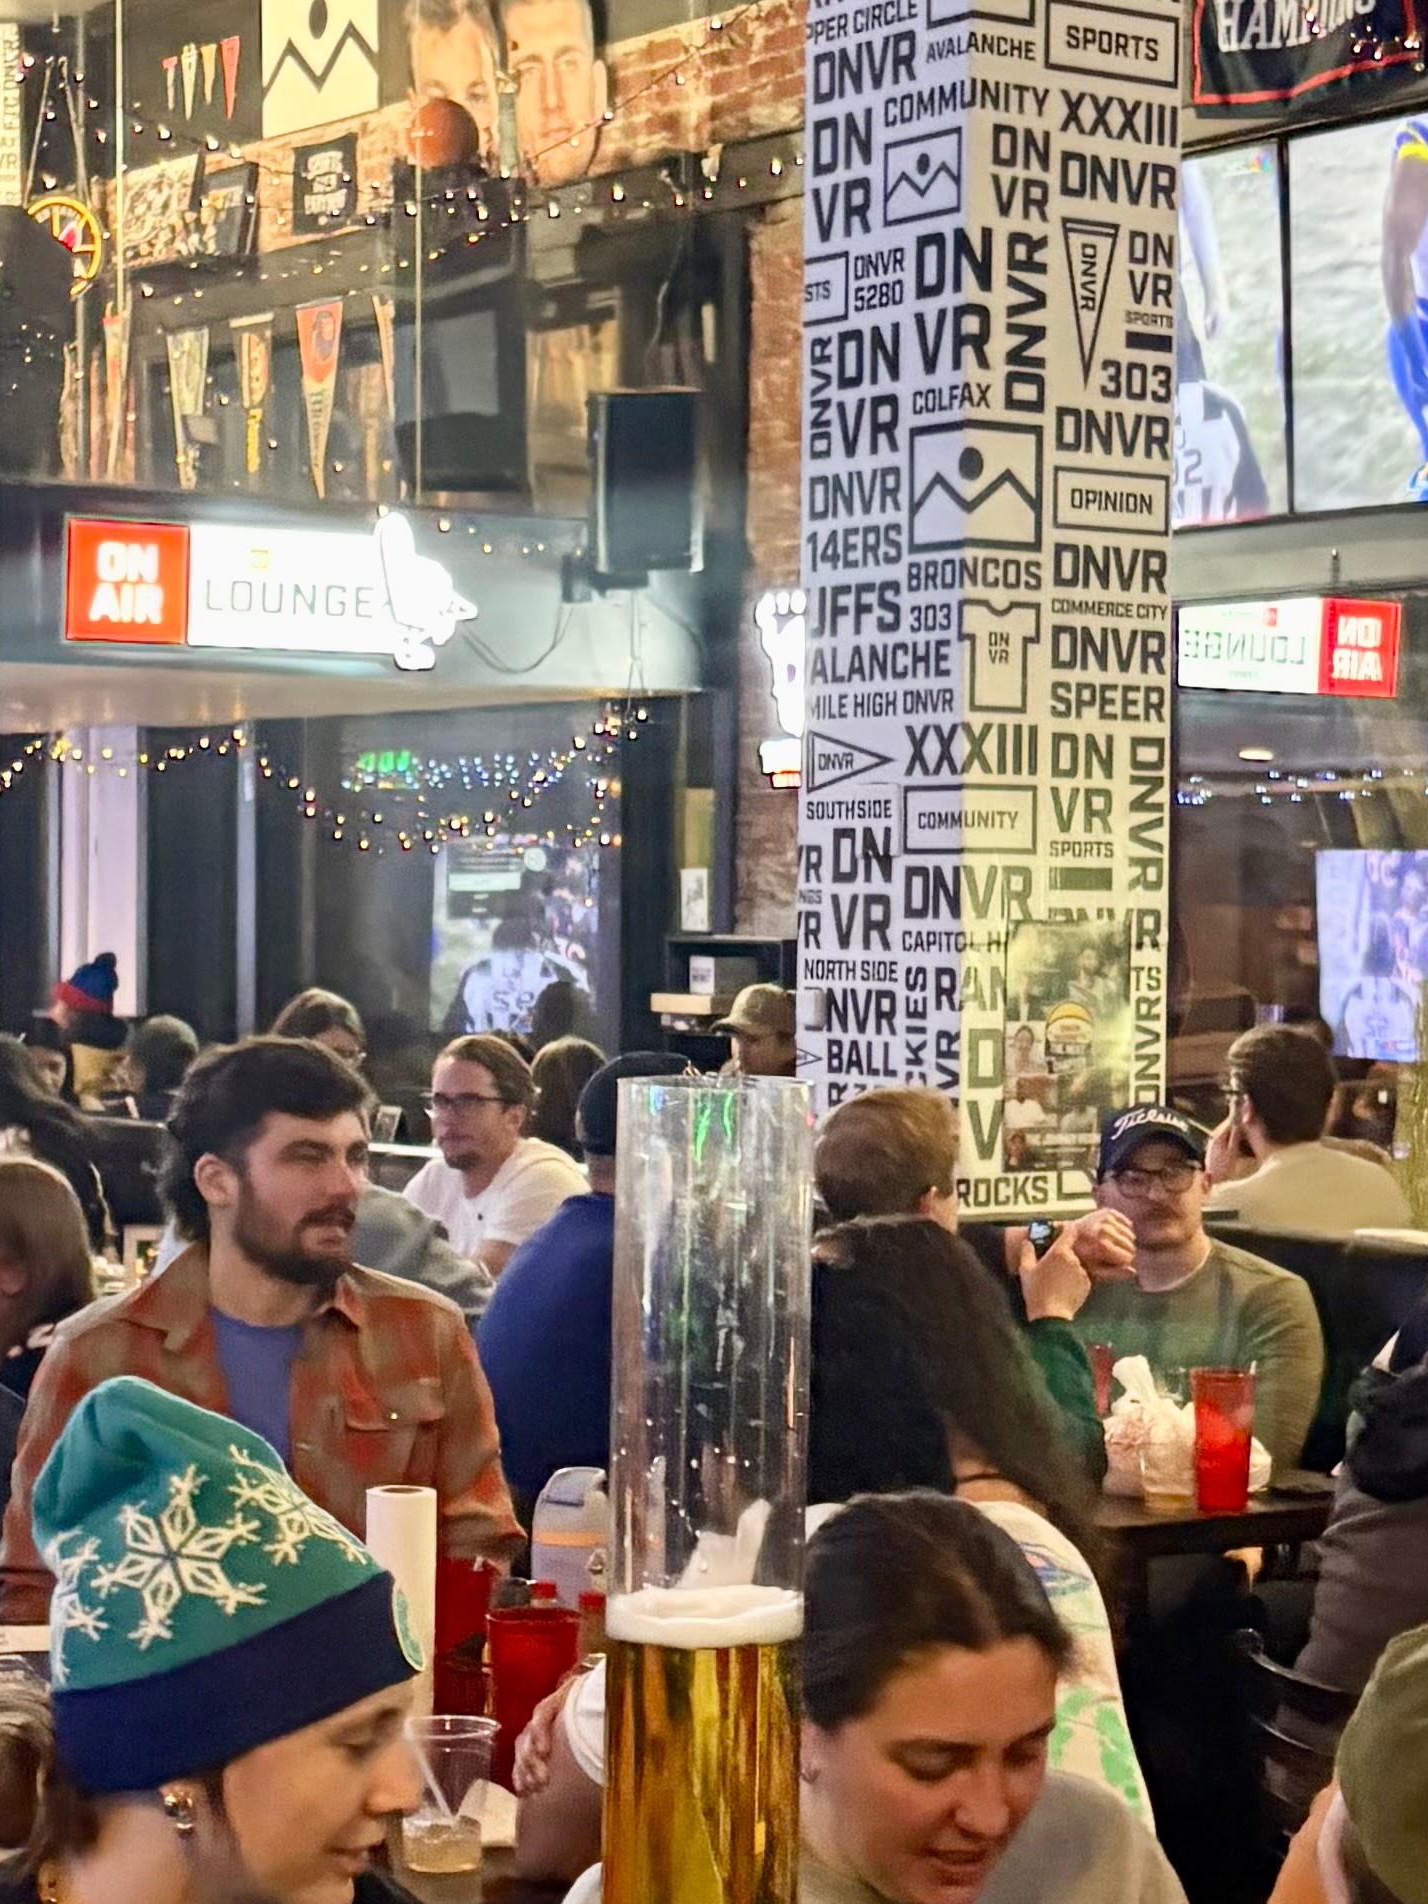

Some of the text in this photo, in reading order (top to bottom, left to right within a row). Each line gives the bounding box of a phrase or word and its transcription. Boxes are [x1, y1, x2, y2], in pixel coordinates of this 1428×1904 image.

[927, 34, 1037, 63] AVALANCHE
[1066, 26, 1159, 61] SPORTS
[814, 31, 915, 104] DNVR
[884, 80, 1049, 127] COMMUNITY
[1060, 90, 1177, 148] XXXIII
[1061, 152, 1176, 210] DNVR
[855, 250, 905, 281] DNVR
[1080, 245, 1097, 312] DNVR
[855, 280, 904, 312] 5280
[1007, 232, 1049, 413] DNVR
[1126, 312, 1173, 327] SPORTS
[811, 336, 832, 460] DNVR
[913, 384, 991, 414] COLFAX
[1101, 361, 1172, 403] 303
[1056, 407, 1169, 460] DNVR
[810, 467, 900, 520] DNVR
[1071, 488, 1153, 515] OPINION
[96, 541, 159, 583] ON
[808, 525, 901, 571] 14ERS
[1053, 543, 1166, 593] DNVR
[908, 556, 1042, 594] BRONCOS
[89, 582, 163, 625] AIR
[206, 579, 374, 619] LOUNGE
[910, 604, 951, 632] 303
[1052, 598, 1167, 620] COMMERCE CITY
[1051, 625, 1166, 674] DNVR
[853, 693, 897, 717] HIGH
[903, 688, 953, 714] DNVR
[1051, 682, 1164, 723] SPEER
[818, 749, 854, 772] DNVR
[904, 723, 1037, 777] XXXIII
[918, 807, 1019, 831] COMMUNITY
[1129, 736, 1164, 892] DNVR
[1049, 840, 1113, 858] SPORTS
[904, 865, 1032, 919] DNVR
[804, 958, 897, 983] NORTH SIDE
[828, 1041, 897, 1076] BALL
